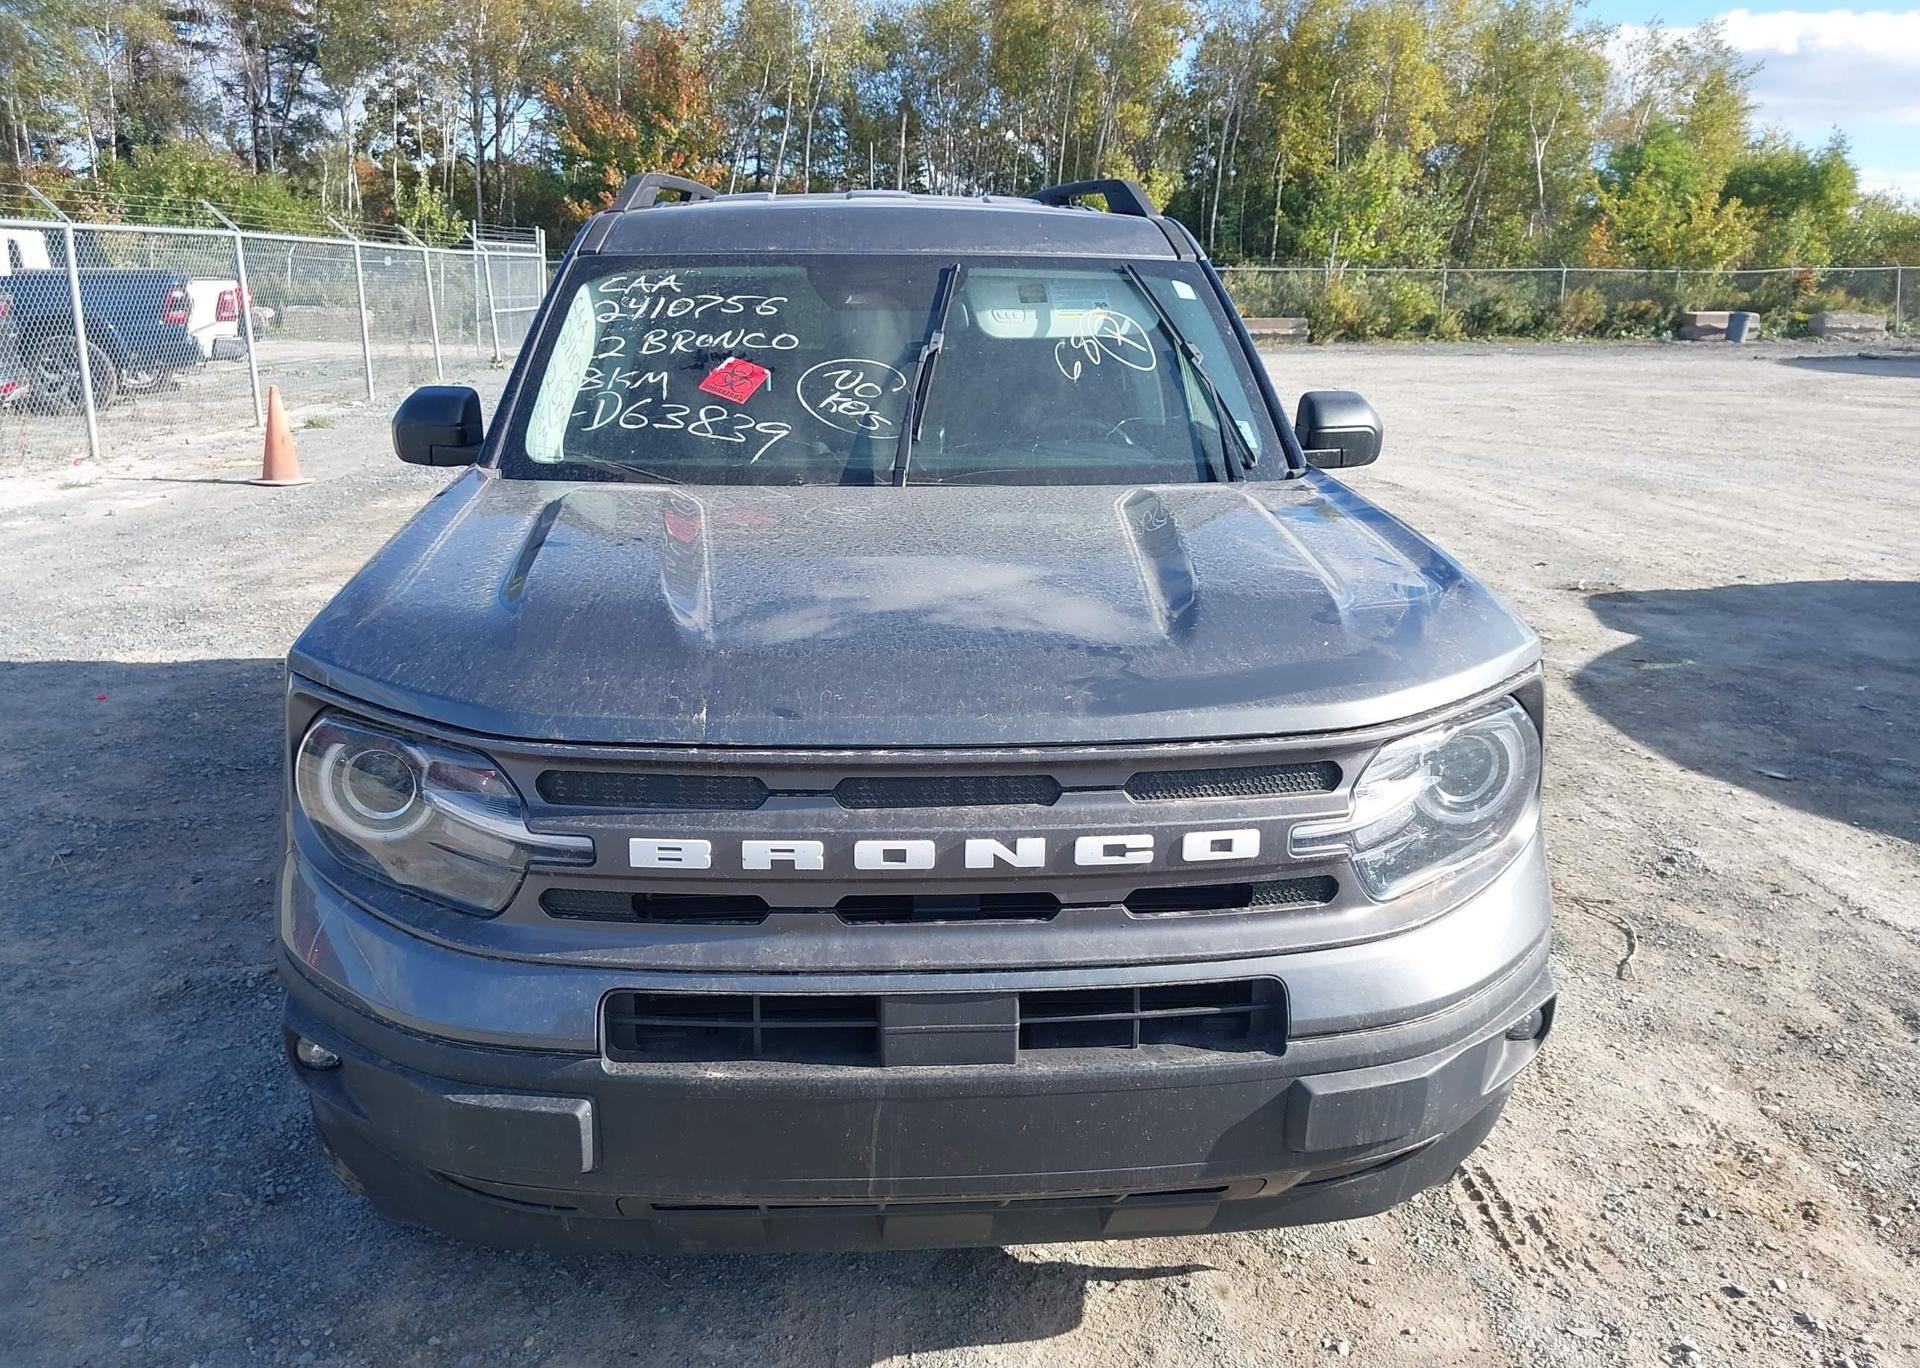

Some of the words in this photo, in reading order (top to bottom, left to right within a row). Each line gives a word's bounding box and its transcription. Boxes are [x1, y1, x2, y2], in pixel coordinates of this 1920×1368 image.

[598, 274, 686, 294] CAA
[595, 295, 789, 324] 2410756
[639, 327, 800, 355] BRONCO
[628, 828, 1261, 871] BRONCO
